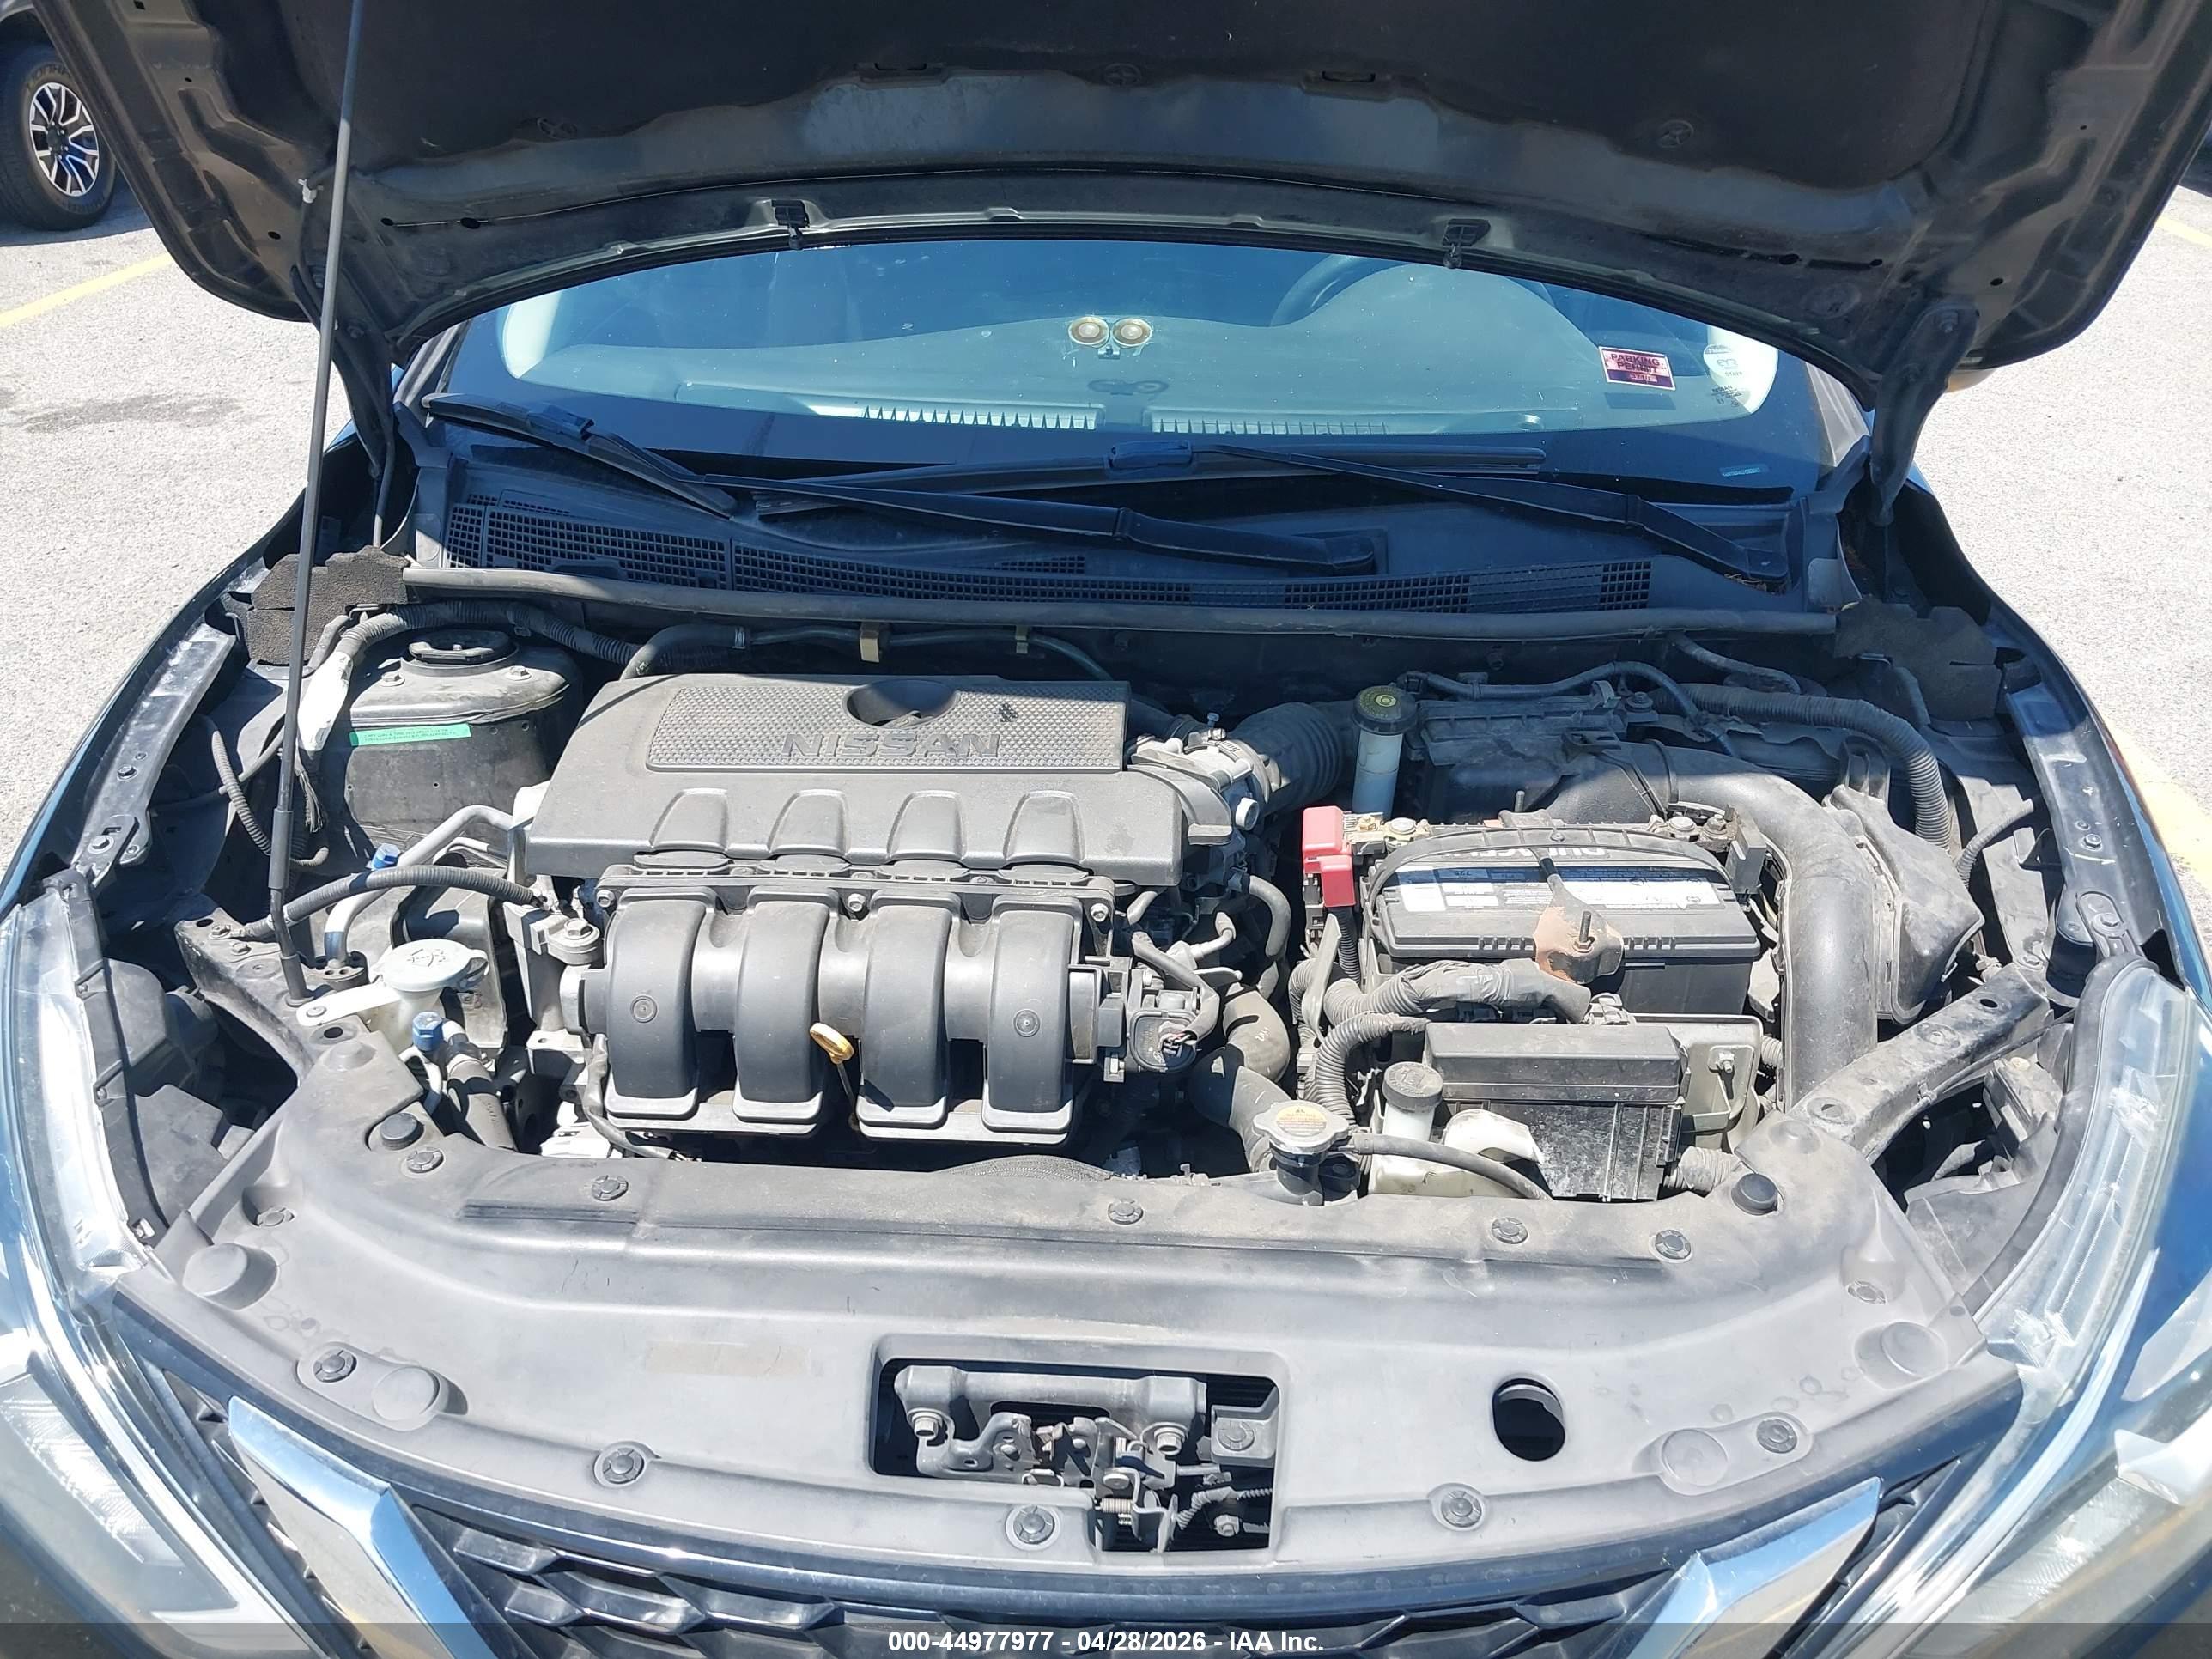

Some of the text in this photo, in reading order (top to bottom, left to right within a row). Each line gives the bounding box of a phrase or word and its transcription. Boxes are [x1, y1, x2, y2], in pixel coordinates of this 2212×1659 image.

[1610, 353, 1661, 367] PARKING
[1616, 362, 1658, 374] PERMIT
[781, 732, 1001, 758] NISSAN
